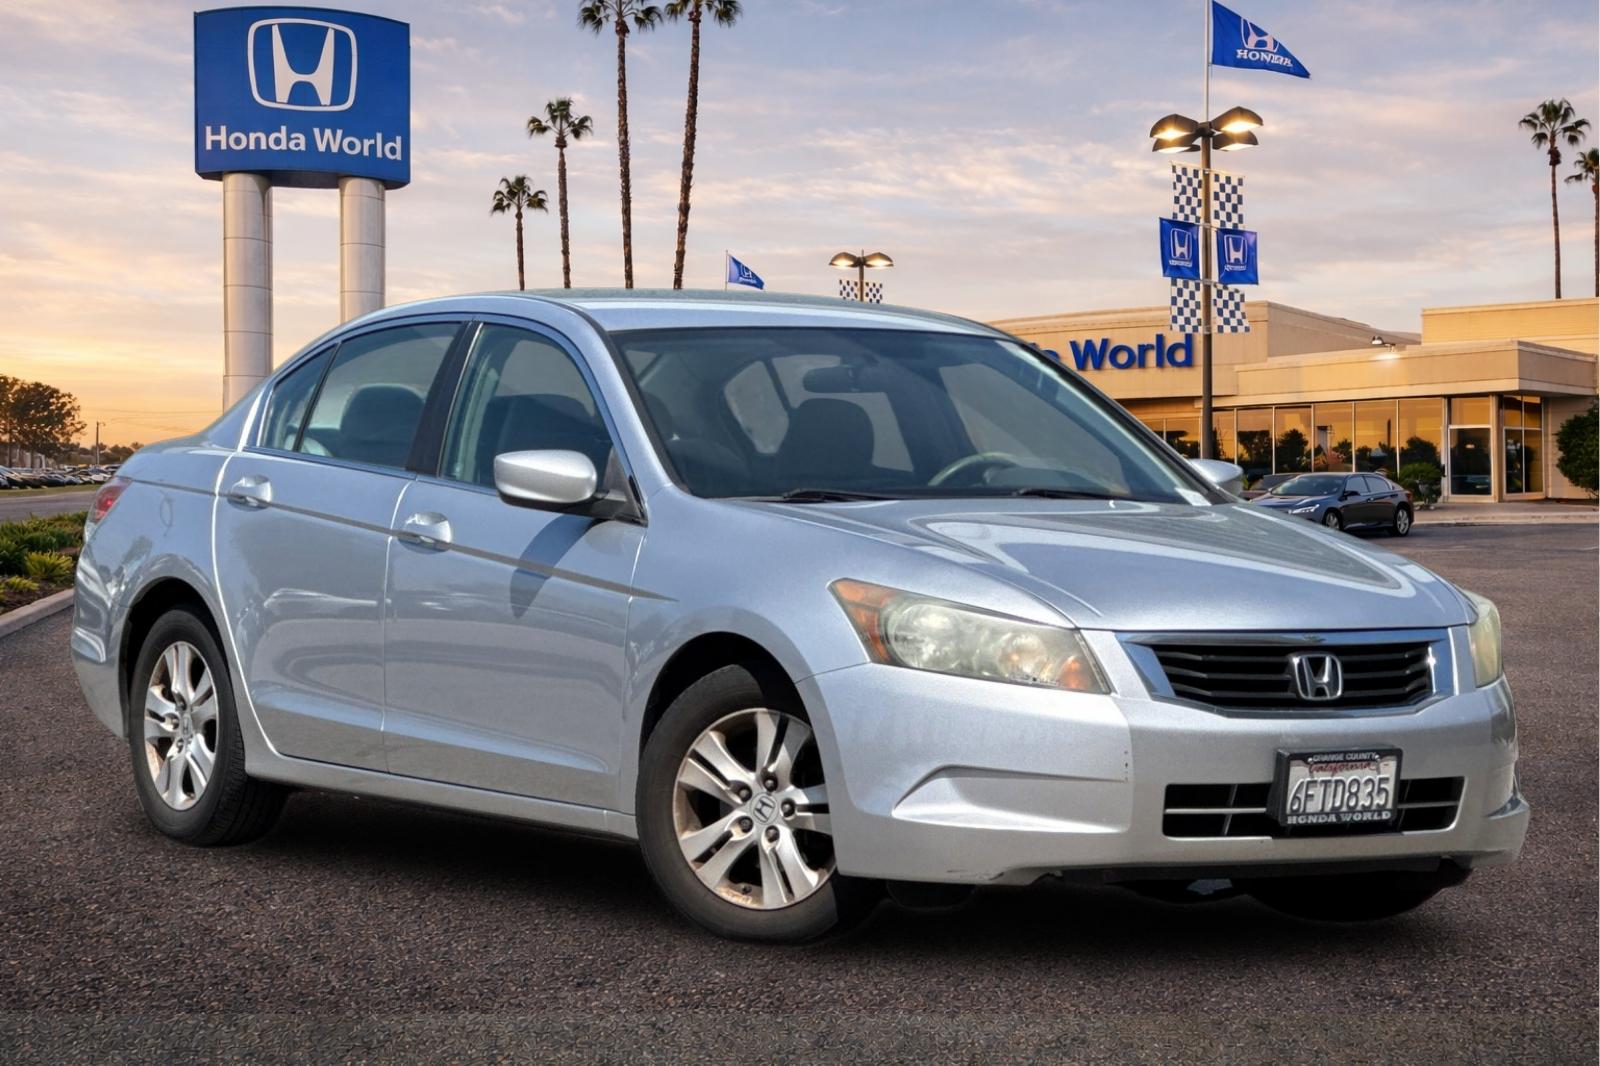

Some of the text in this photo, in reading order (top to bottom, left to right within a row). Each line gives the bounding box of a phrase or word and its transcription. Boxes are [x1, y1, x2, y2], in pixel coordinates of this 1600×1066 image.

[205, 125, 402, 160] Honda World
[1069, 333, 1194, 371] World
[1289, 775, 1390, 814] 6FTD835
[1287, 811, 1391, 824] HONDA WORLD
